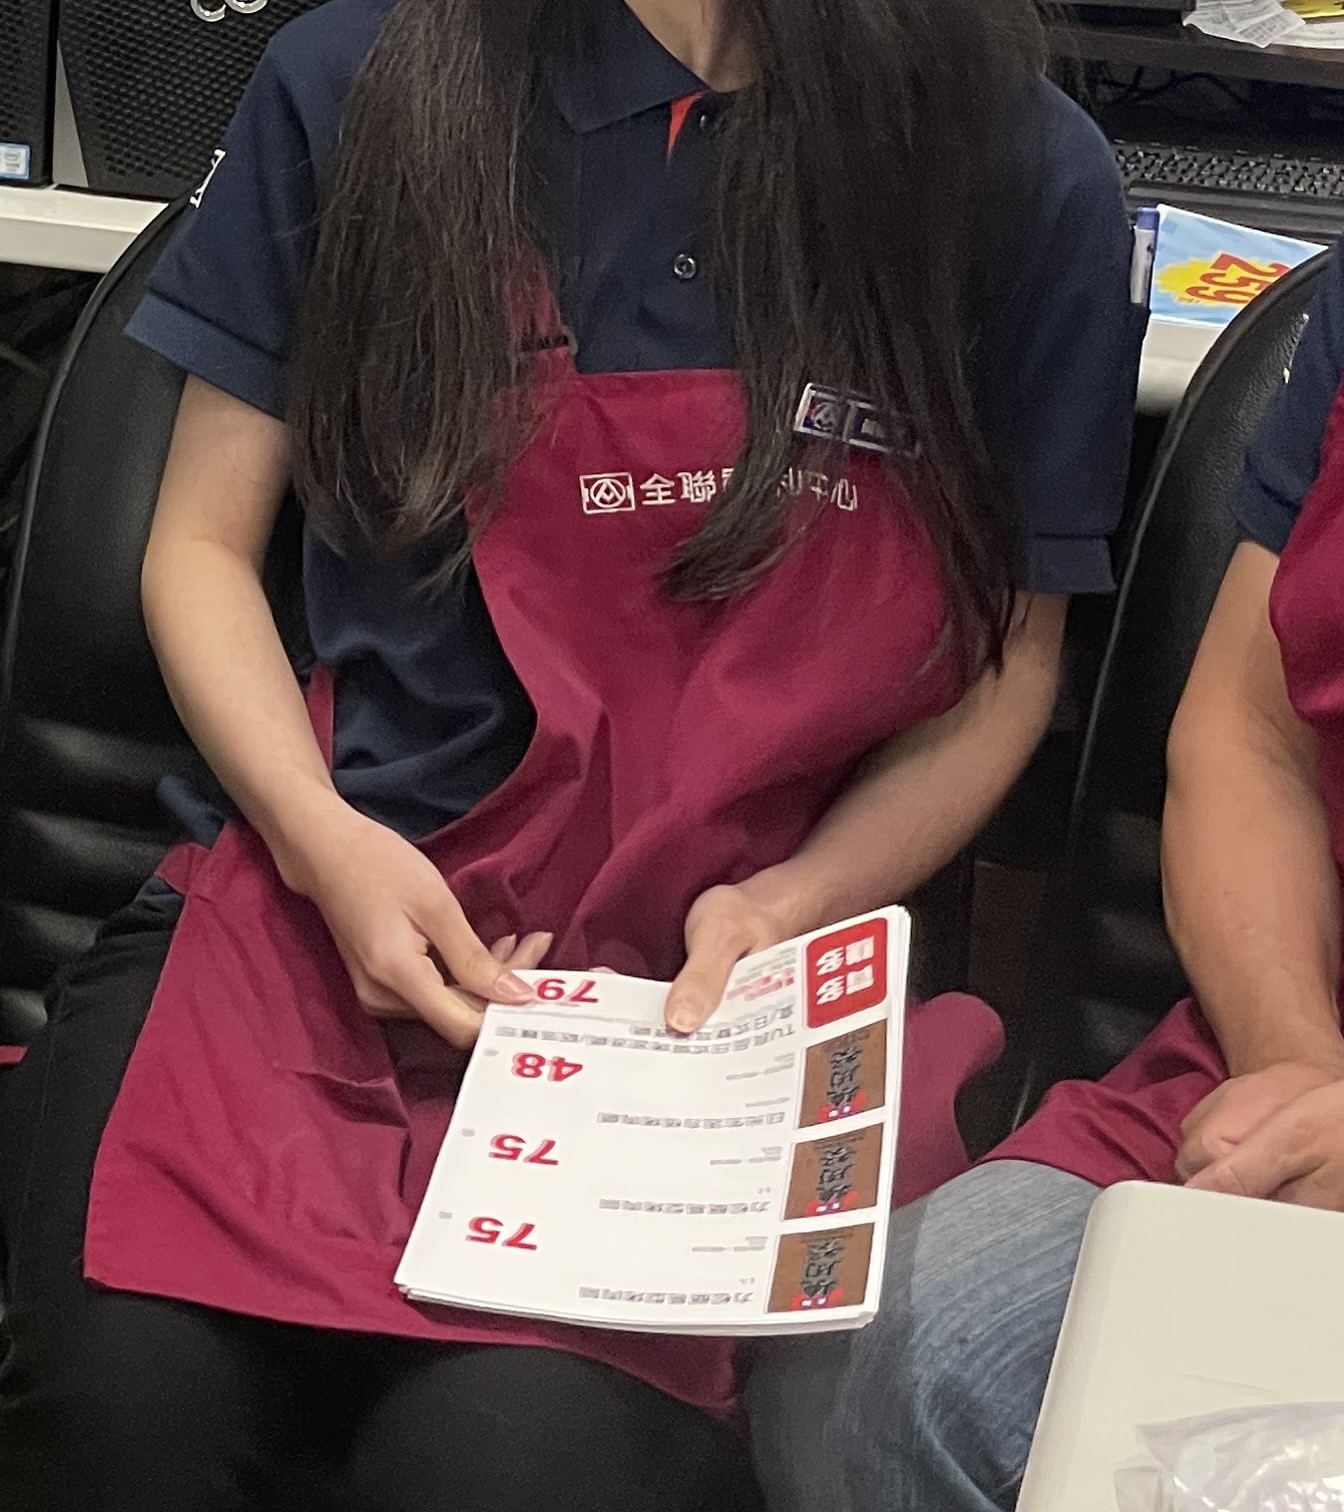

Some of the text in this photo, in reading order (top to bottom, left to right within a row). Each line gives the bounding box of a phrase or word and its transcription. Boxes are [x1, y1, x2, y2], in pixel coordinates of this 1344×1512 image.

[536, 977, 600, 1004] 79
[511, 1053, 583, 1082] 48
[489, 1133, 559, 1166] 75
[465, 1216, 538, 1250] 75
